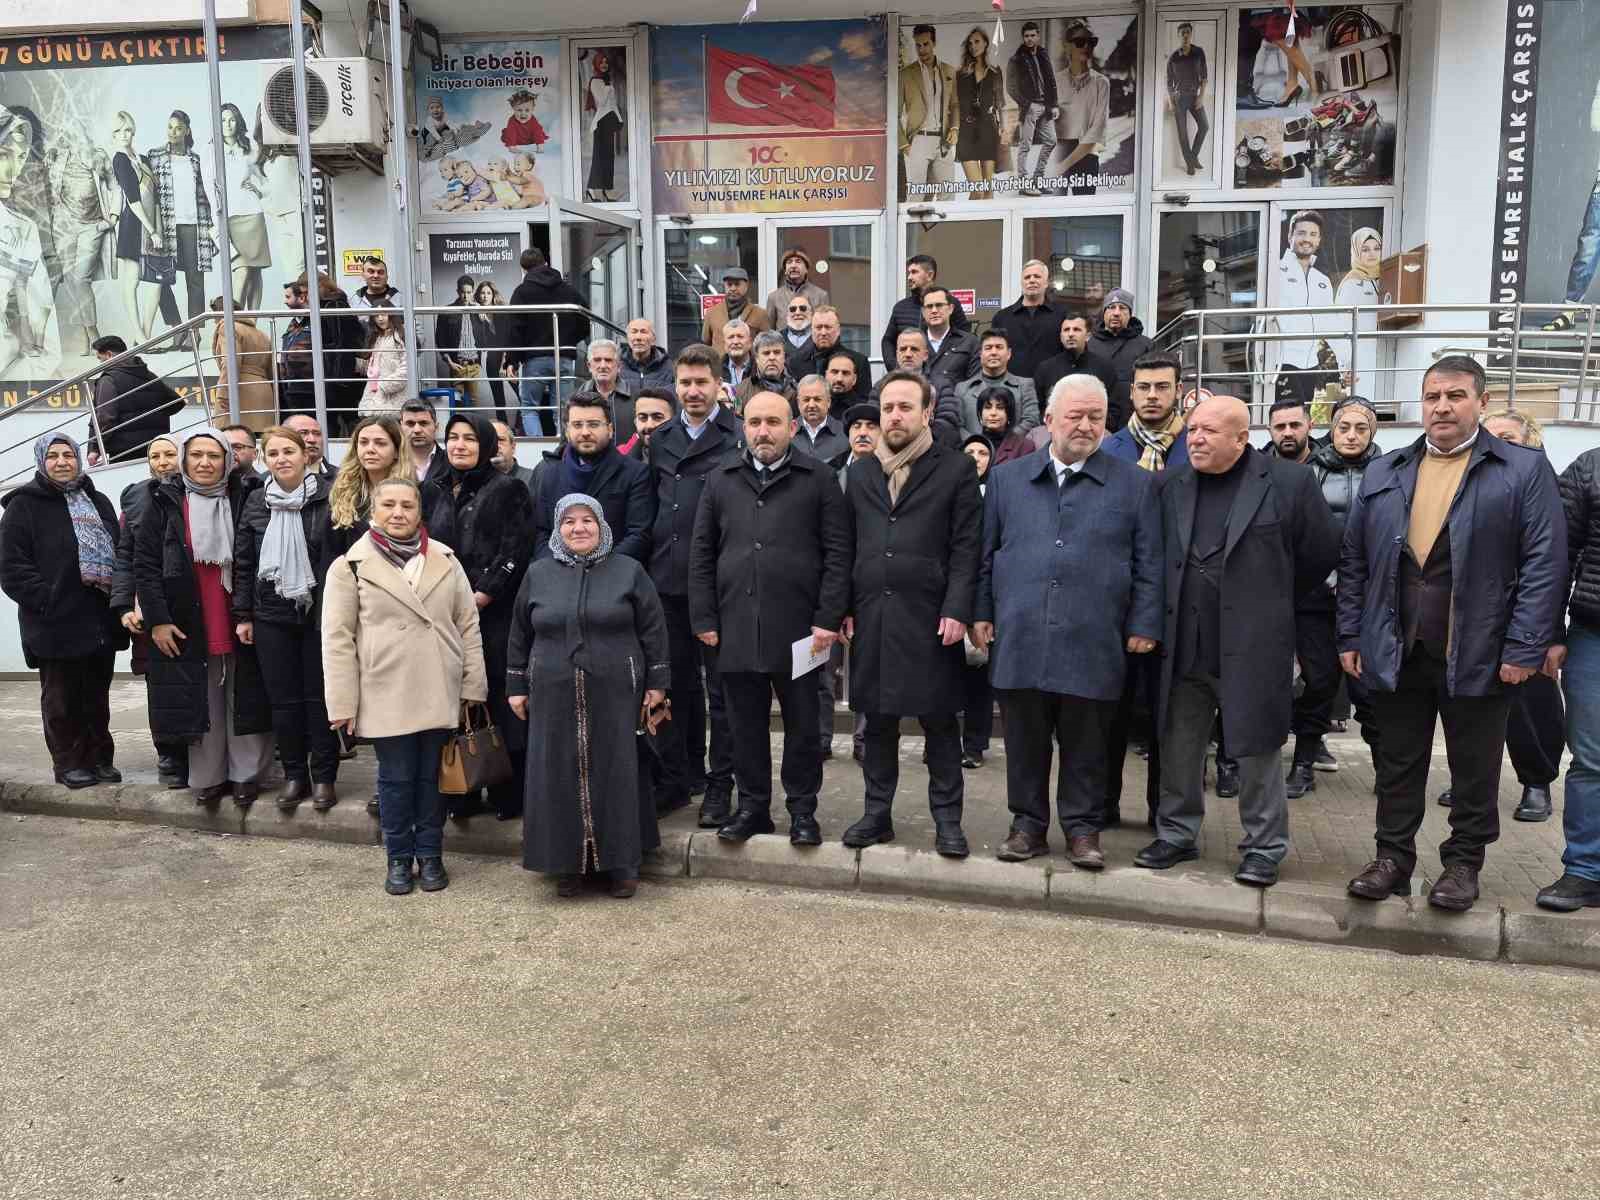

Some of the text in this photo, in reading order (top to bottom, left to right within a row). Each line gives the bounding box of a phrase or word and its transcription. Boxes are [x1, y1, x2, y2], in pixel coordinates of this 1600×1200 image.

[17, 36, 92, 64] GÜNÜ
[431, 51, 544, 73] Bir Bebeğin
[337, 63, 356, 117] arçelik
[427, 76, 548, 91] İhtiyacı Olan Herşey
[1507, 111, 1528, 183] HALK
[664, 165, 876, 187] YILIMIZI KUTLUYORUZ
[1037, 176, 1068, 189] Burada
[1069, 173, 1085, 188] Sizi
[691, 187, 848, 202] YUNUSEMRE HALK ÇARŞISI
[1502, 191, 1522, 262] EMRE
